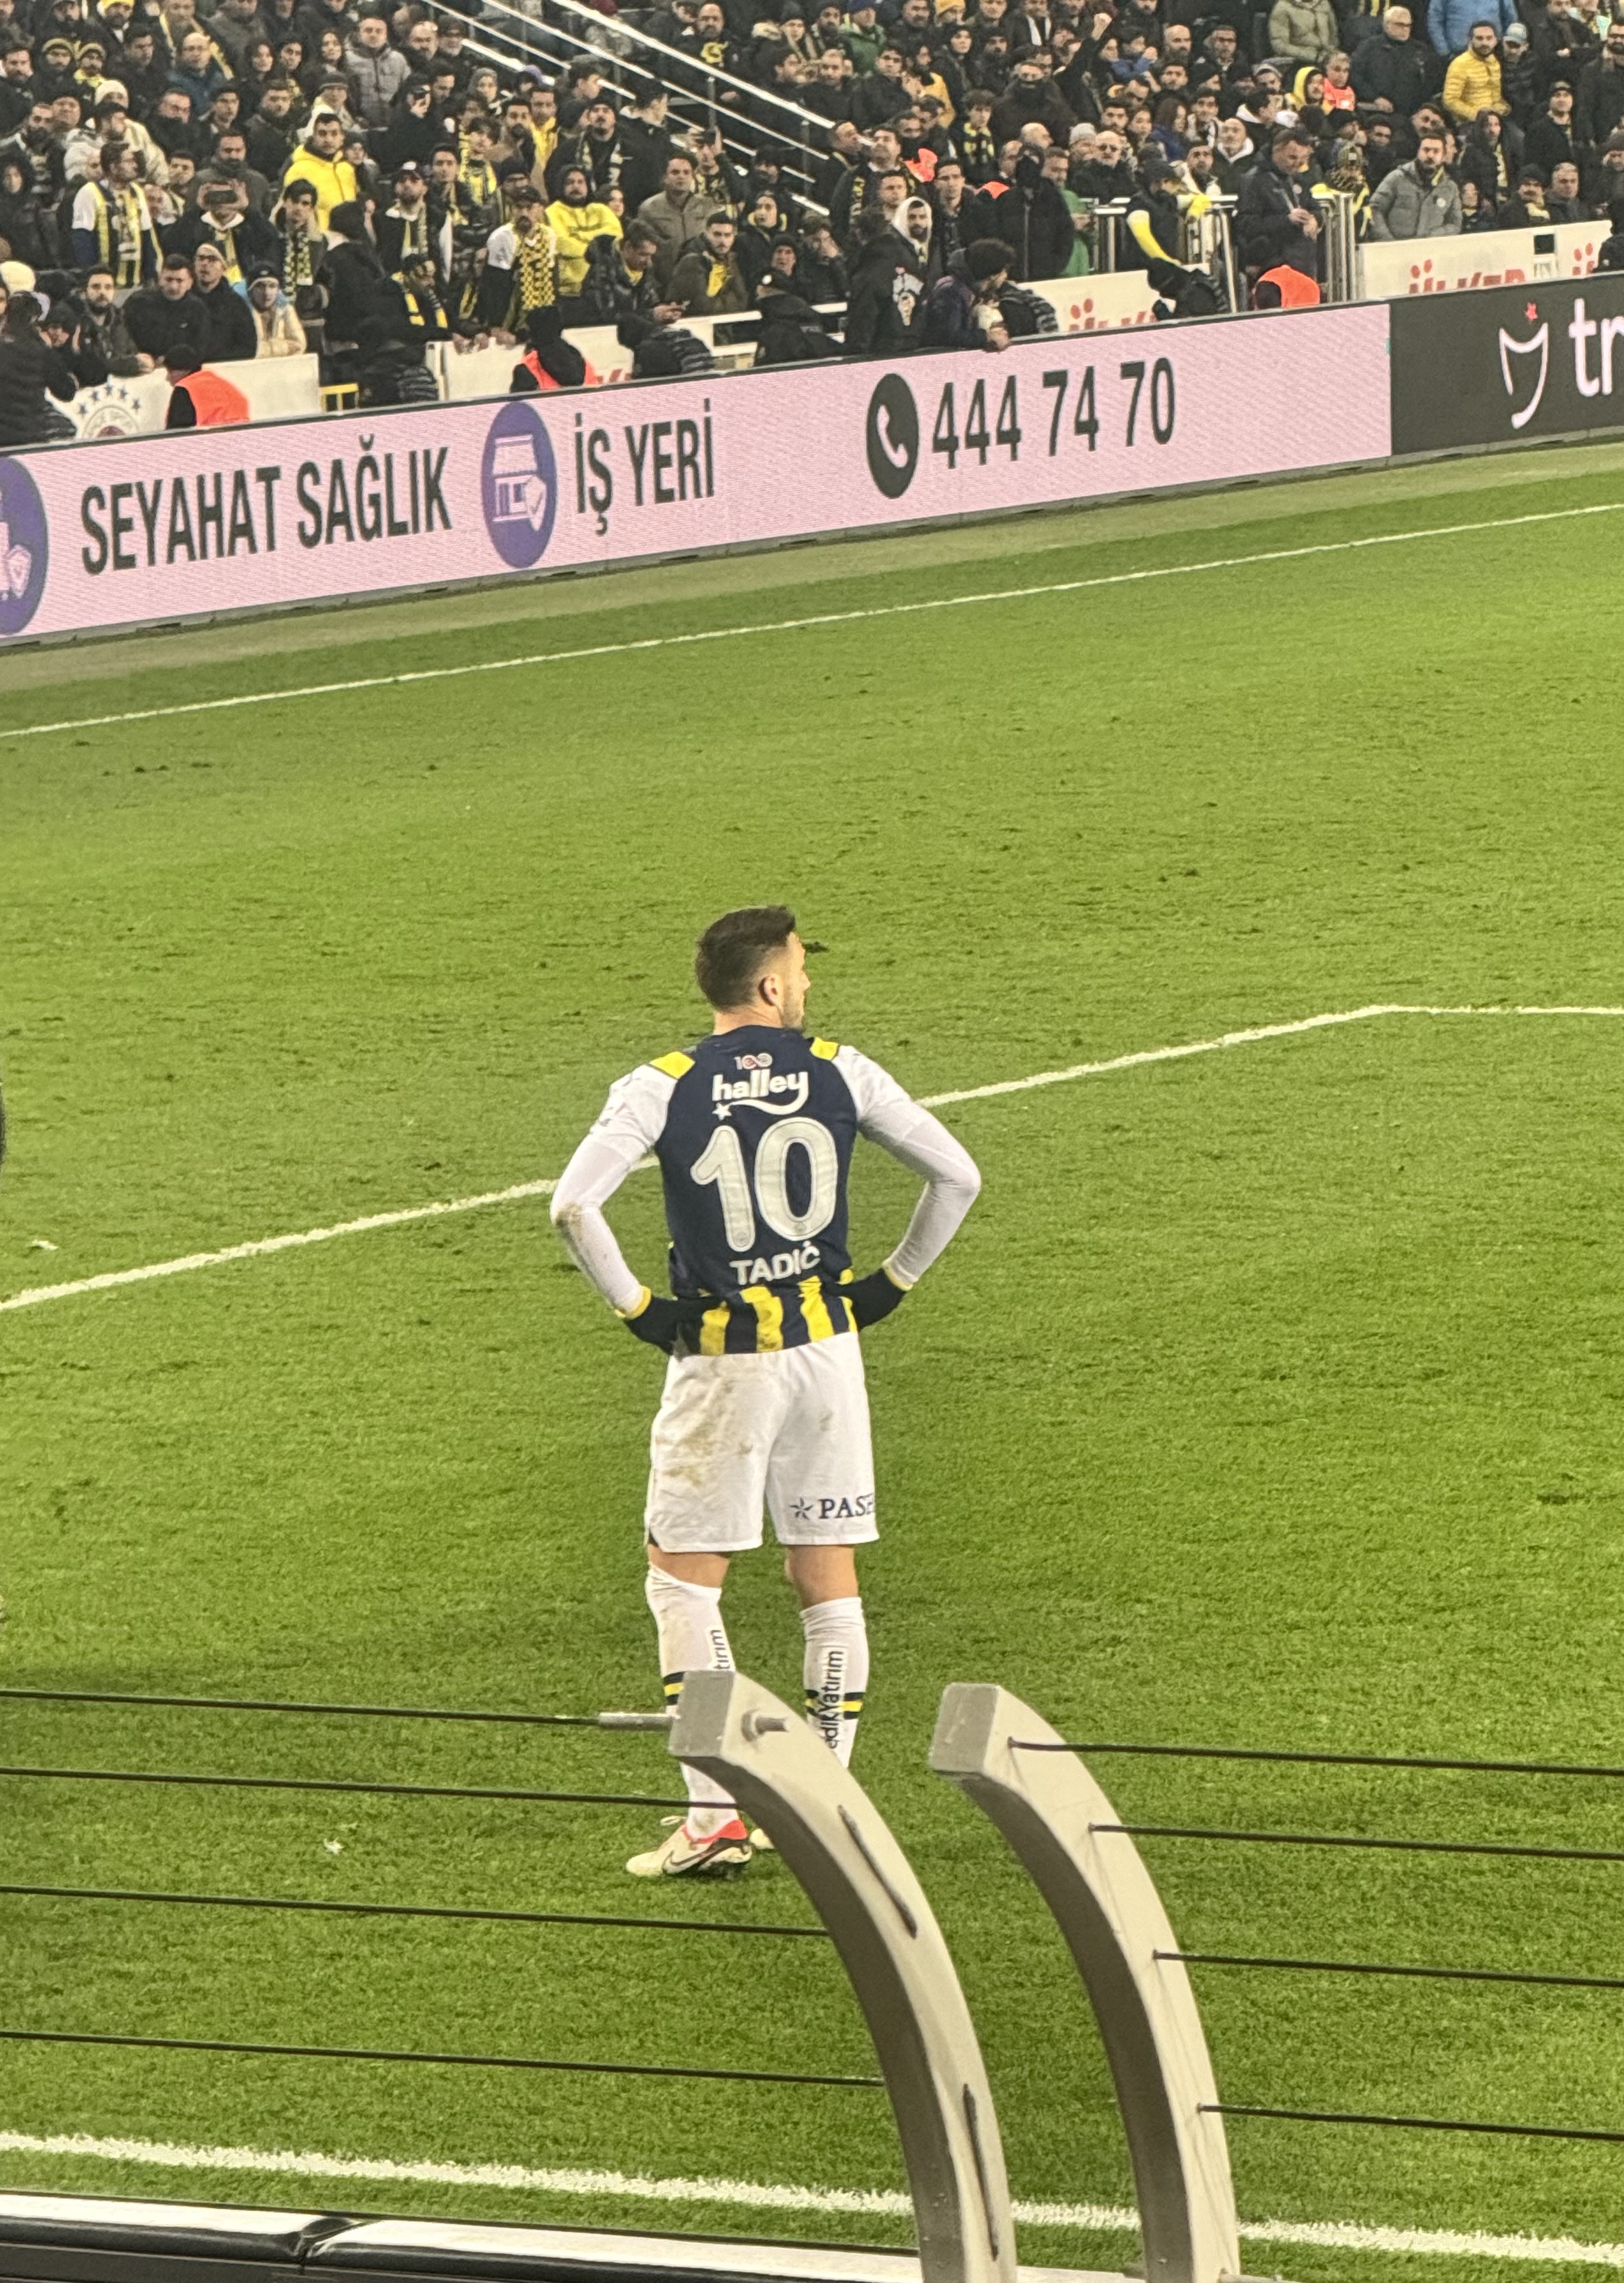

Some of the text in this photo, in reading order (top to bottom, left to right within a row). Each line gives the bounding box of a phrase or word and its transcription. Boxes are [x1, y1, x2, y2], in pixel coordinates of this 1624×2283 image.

[574, 397, 715, 536] İŞ YERİ
[931, 357, 1177, 469] 444 74 70
[80, 434, 453, 576] SEYAHAT SAĞLIK
[711, 1068, 809, 1115] halley
[690, 1116, 839, 1252] 10
[711, 1629, 730, 1670] tırım
